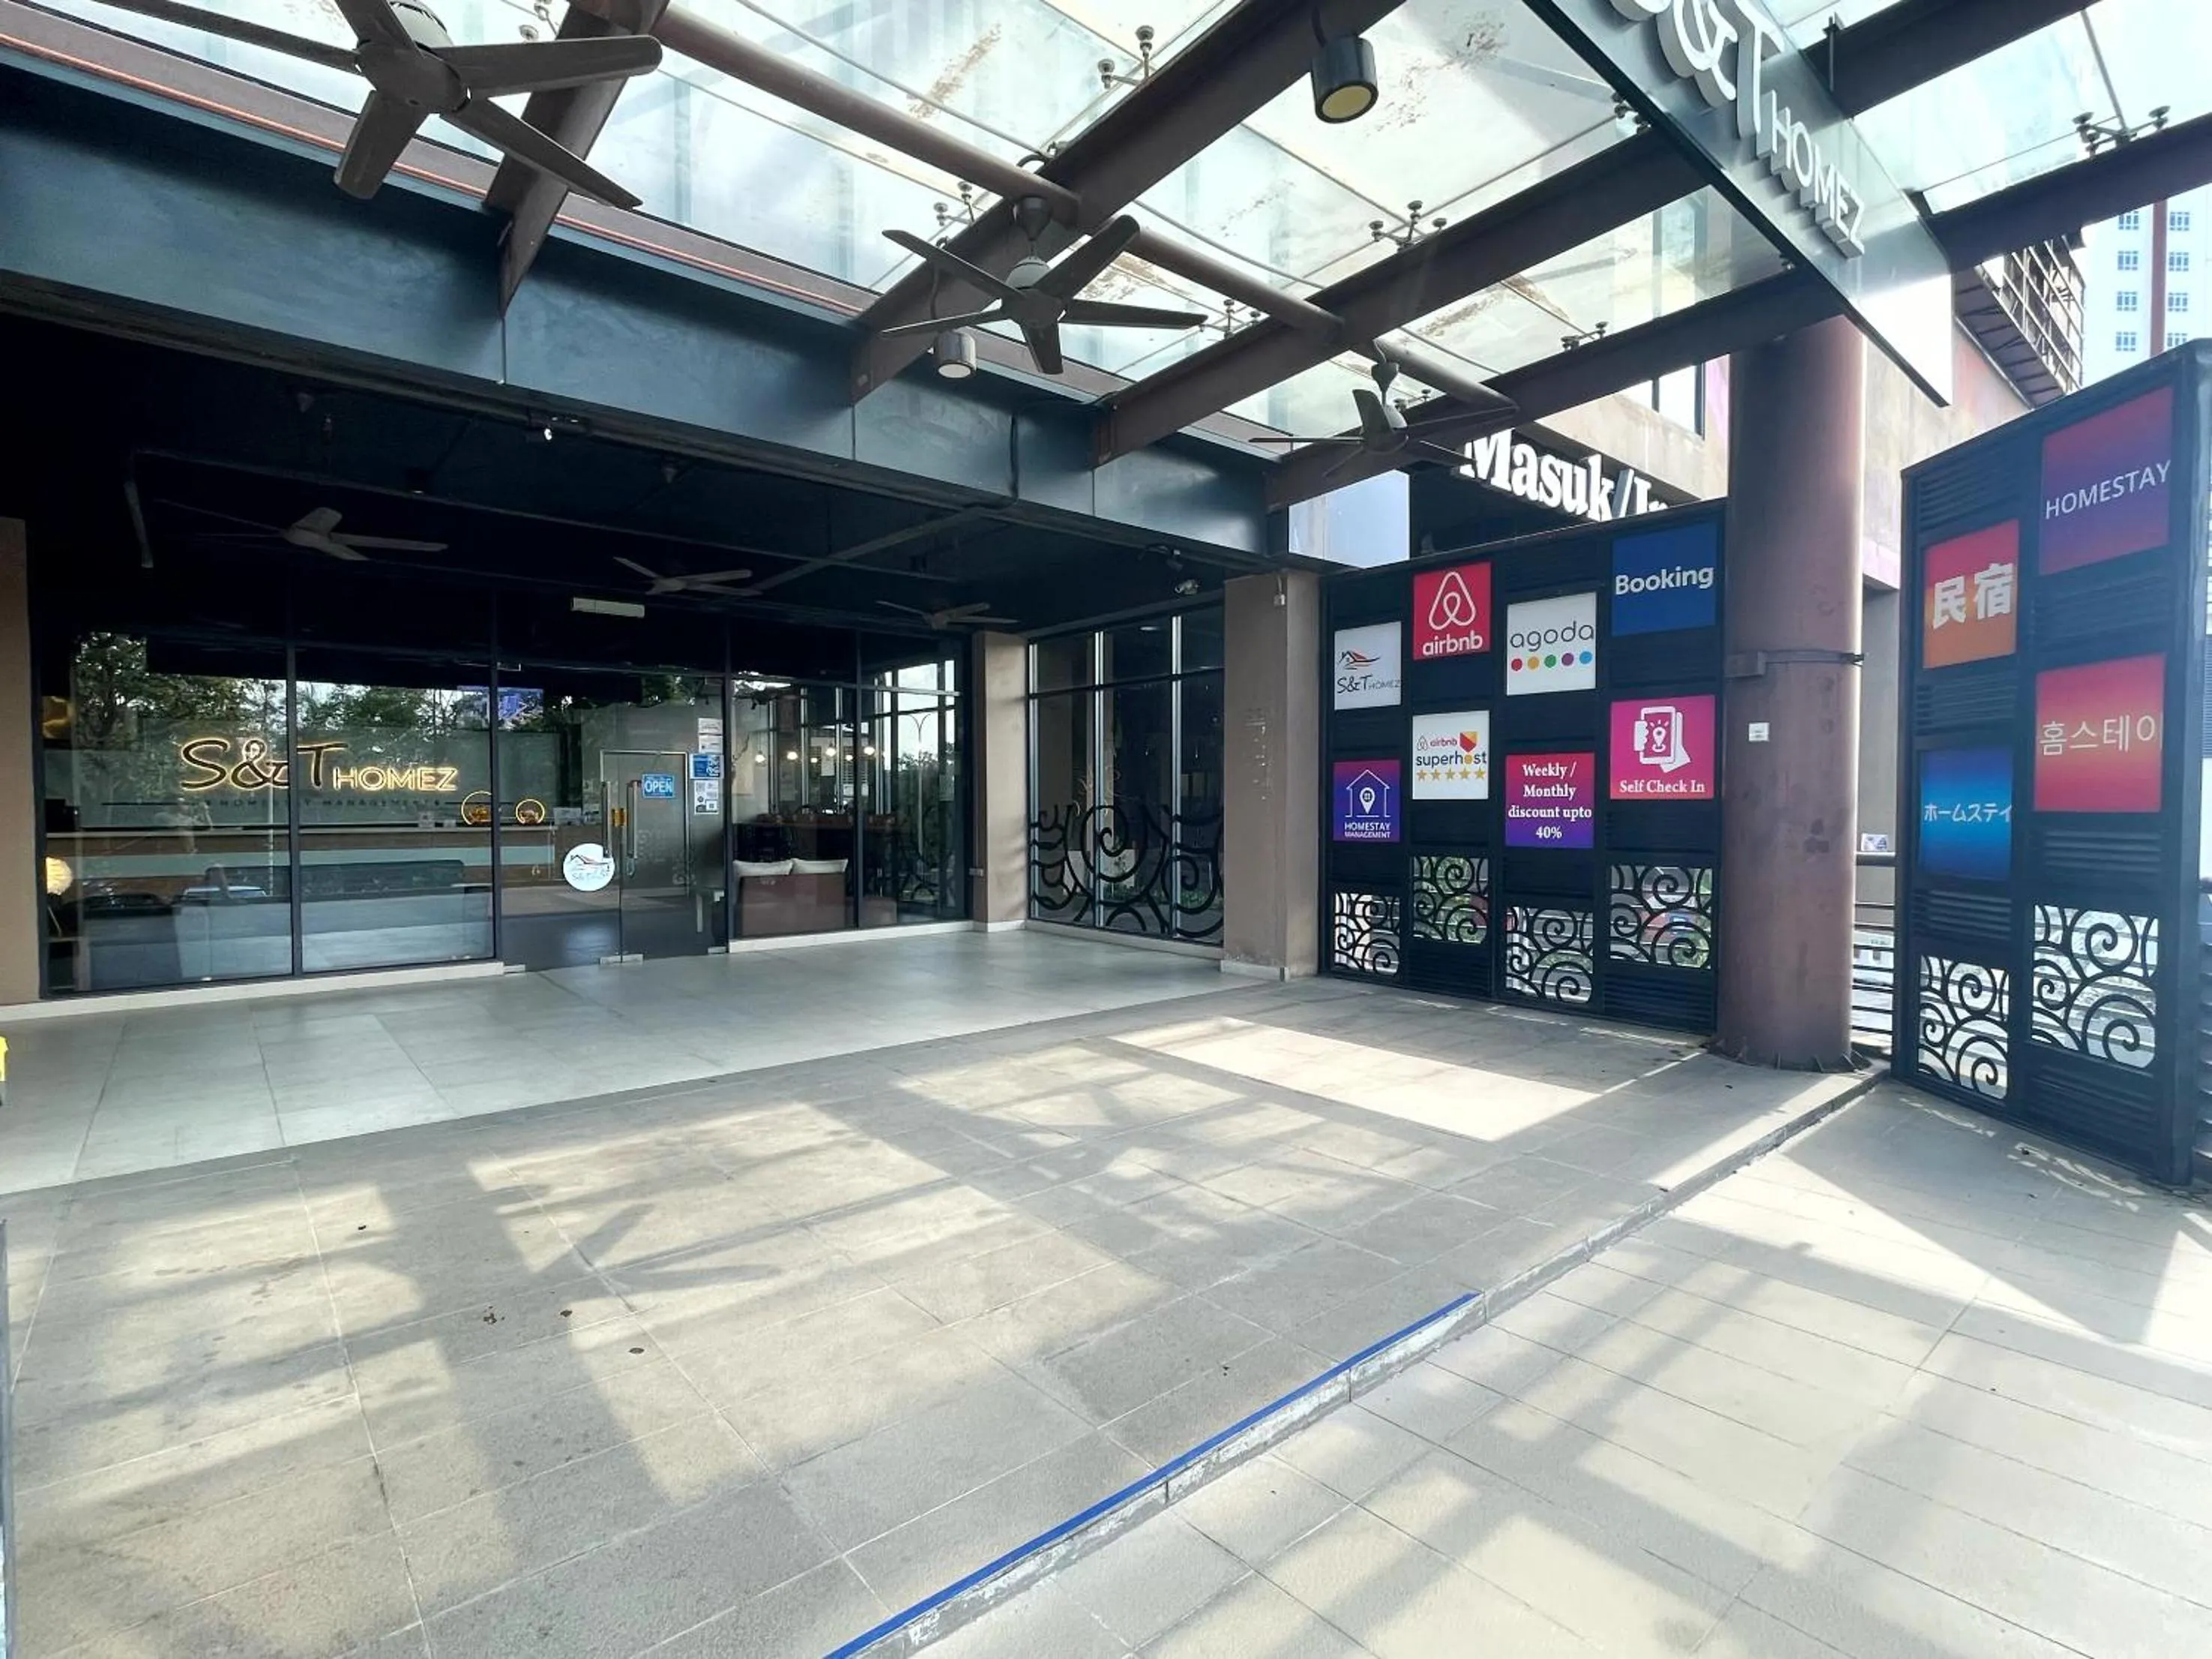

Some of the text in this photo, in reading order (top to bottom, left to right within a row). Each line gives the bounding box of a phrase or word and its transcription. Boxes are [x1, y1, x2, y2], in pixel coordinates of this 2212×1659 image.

[1757, 89, 1865, 259] HOMEZ
[2045, 460, 2171, 520] HOMESTAY
[1615, 566, 1714, 595] Booking
[1933, 563, 2013, 629] 民宿
[1422, 630, 1483, 656] airbnb
[1510, 621, 1594, 651] agoda
[1336, 675, 1372, 694] S&T
[1430, 736, 1458, 747] airbnb
[180, 738, 459, 792] S&T HOMEZ
[1416, 750, 1487, 768] superhost
[1522, 763, 1567, 779] Weekly
[644, 778, 672, 792] OPEN
[1522, 784, 1576, 801] Monthly
[1619, 780, 1705, 793] Self Check In
[1508, 805, 1592, 822] discount upto
[1344, 822, 1391, 831] HOMESTAY
[1535, 826, 1563, 839] 40%
